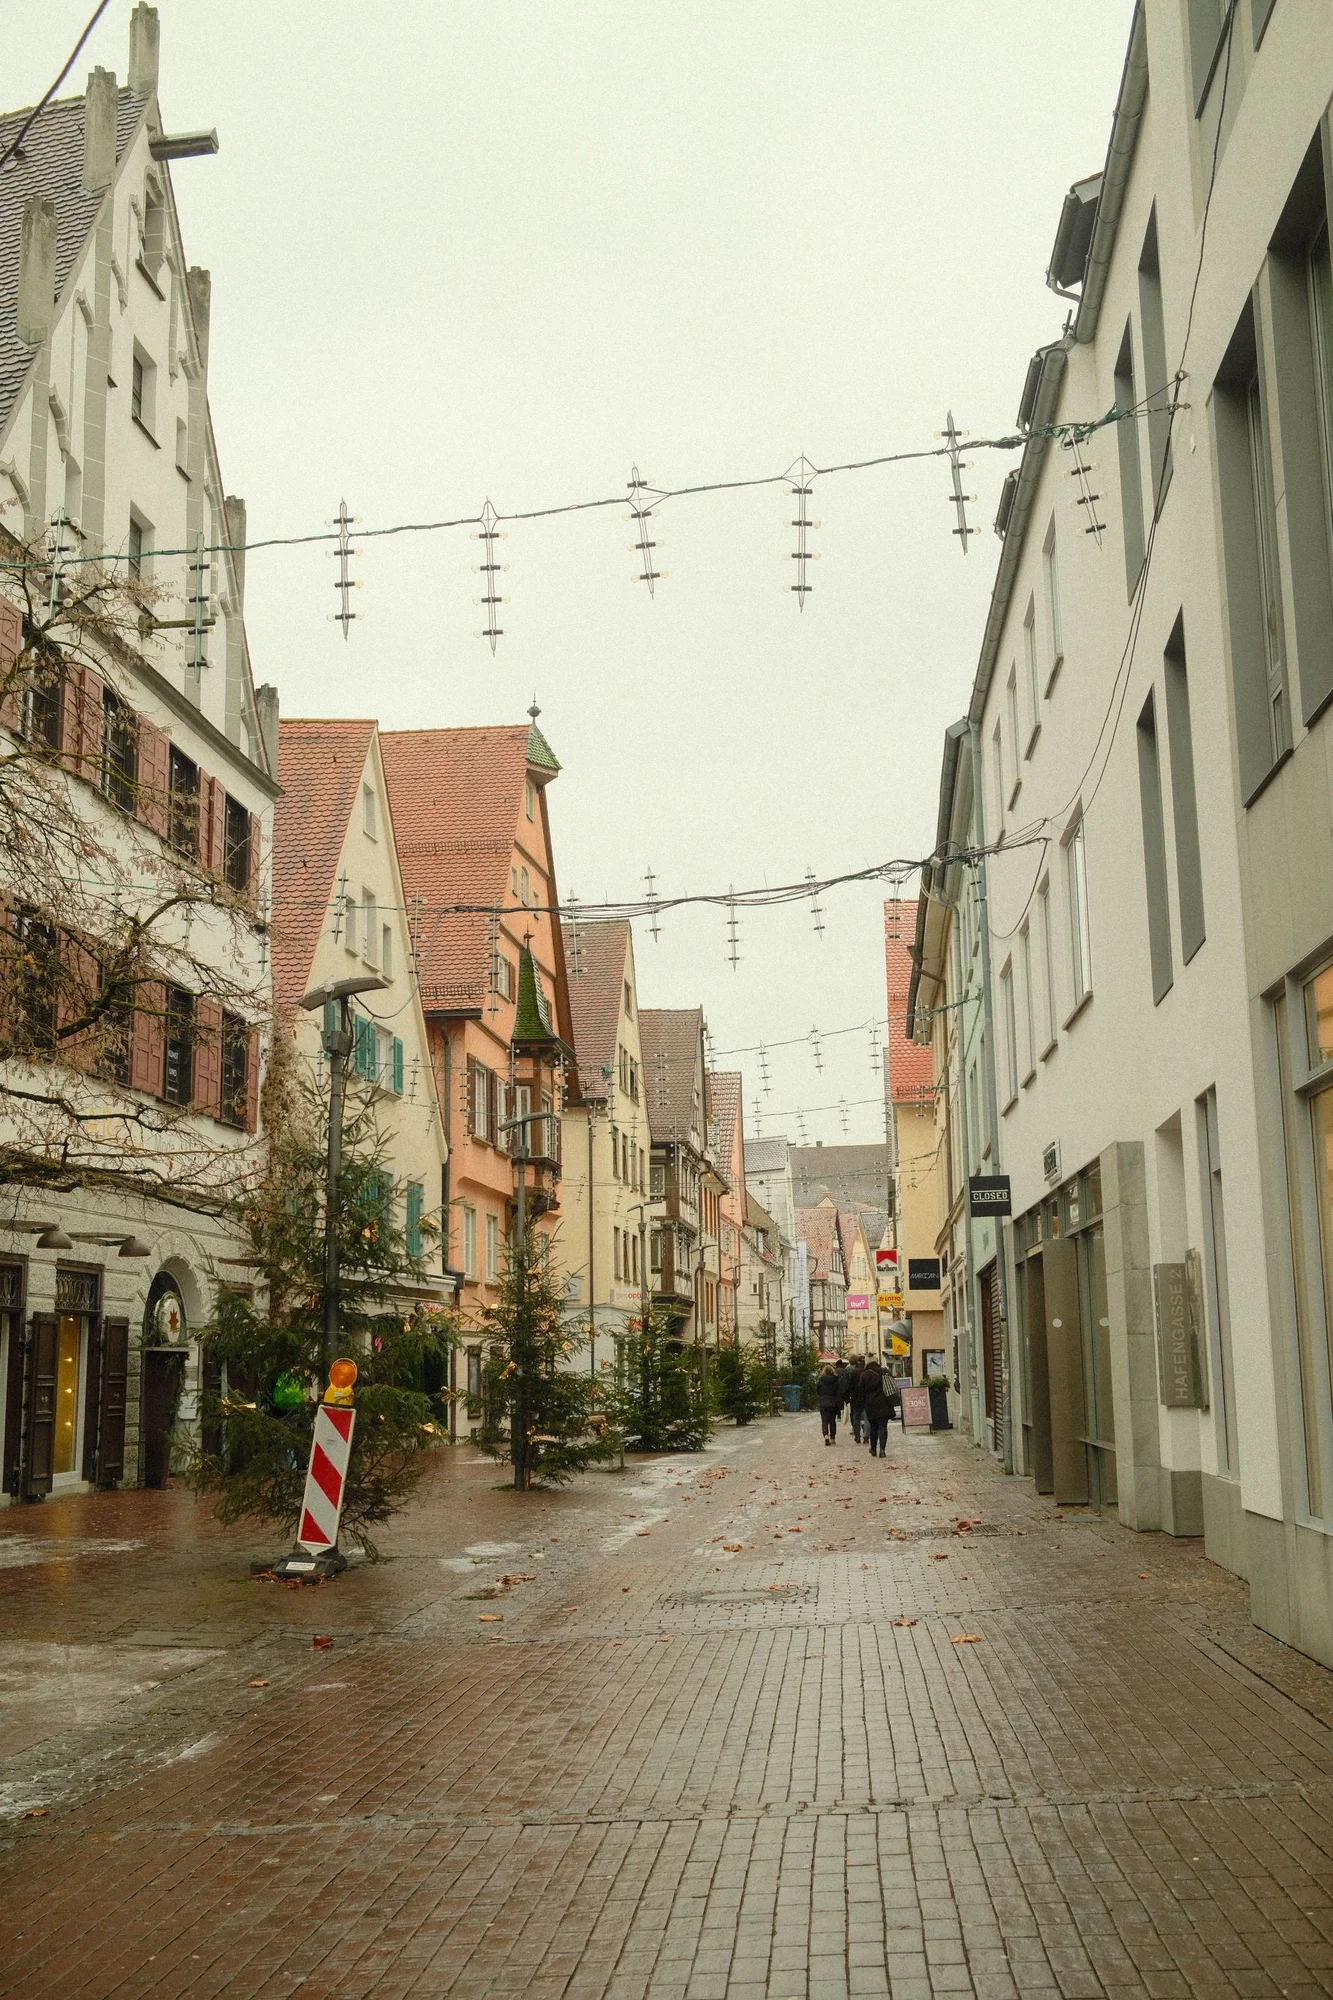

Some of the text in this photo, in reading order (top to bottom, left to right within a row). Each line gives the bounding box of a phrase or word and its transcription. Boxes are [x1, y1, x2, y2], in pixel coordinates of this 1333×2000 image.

[973, 1191, 1008, 1201] CLOSED
[877, 1264, 898, 1273] Marlboro
[1169, 1269, 1188, 1399] HAFENGASSE 2
